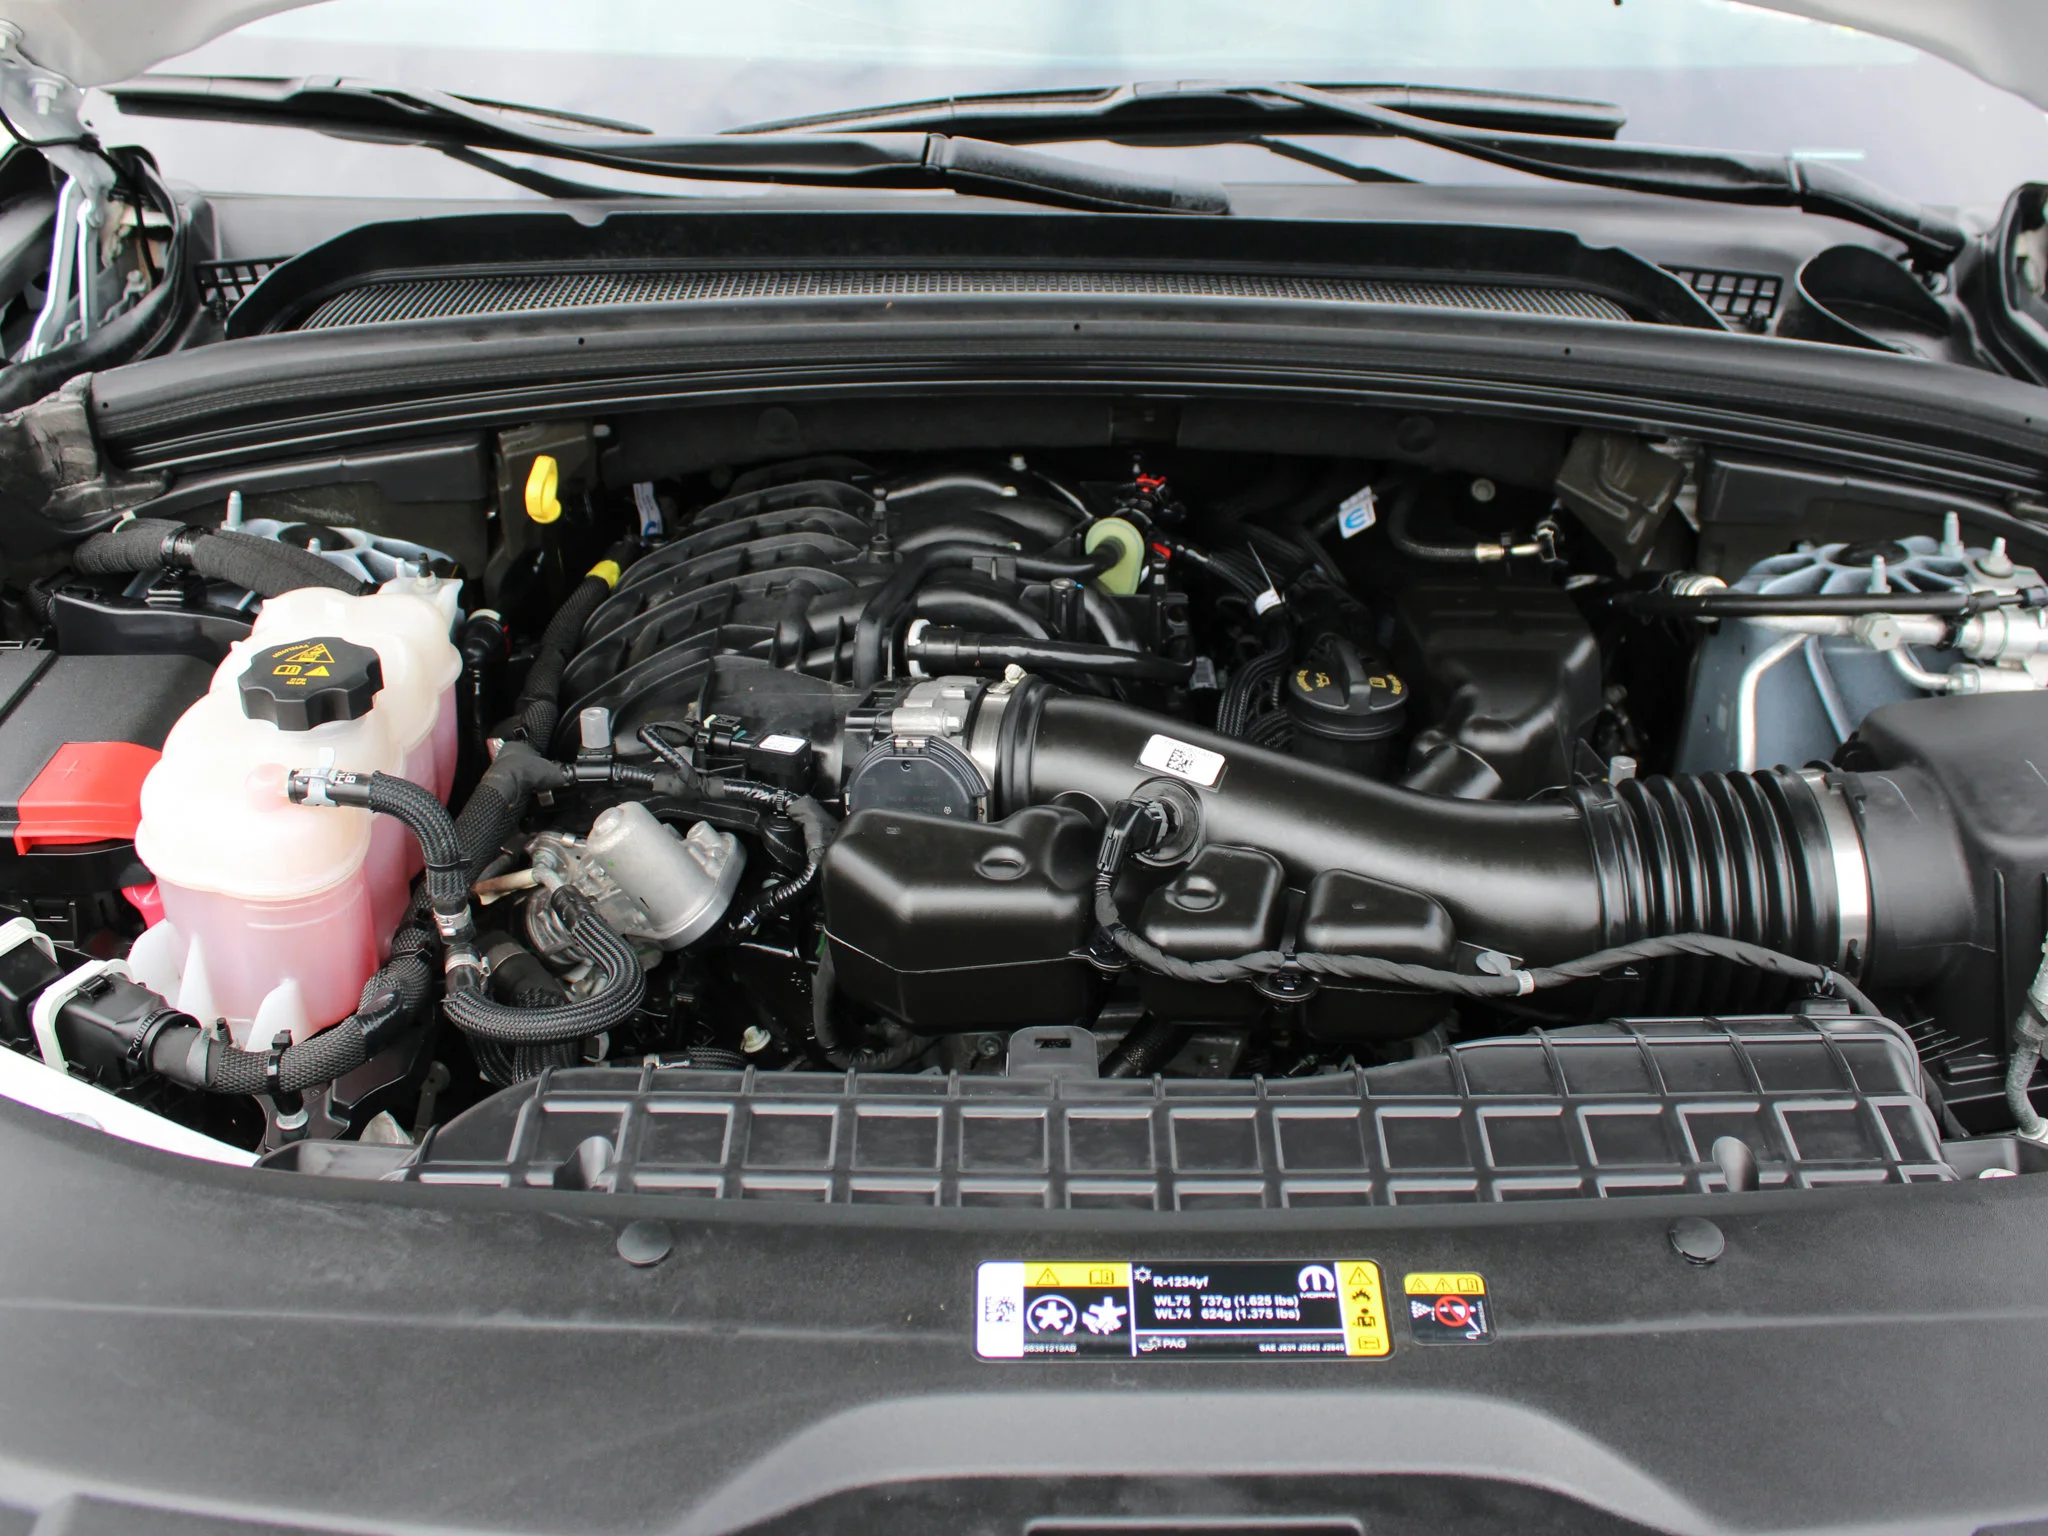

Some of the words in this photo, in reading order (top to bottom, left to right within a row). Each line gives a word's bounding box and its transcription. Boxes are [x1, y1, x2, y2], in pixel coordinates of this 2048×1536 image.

[1153, 1276, 1209, 1290] R-1234yf
[1153, 1295, 1191, 1307] WL75
[1200, 1295, 1232, 1309] 737g
[1234, 1295, 1272, 1309] (1.625
[1275, 1294, 1300, 1308] lbs)
[1154, 1308, 1192, 1320] WL74
[1201, 1308, 1232, 1322] 624g
[1235, 1308, 1274, 1321] (1.375
[1276, 1307, 1301, 1321] lbs)
[1162, 1338, 1187, 1349] PAG
